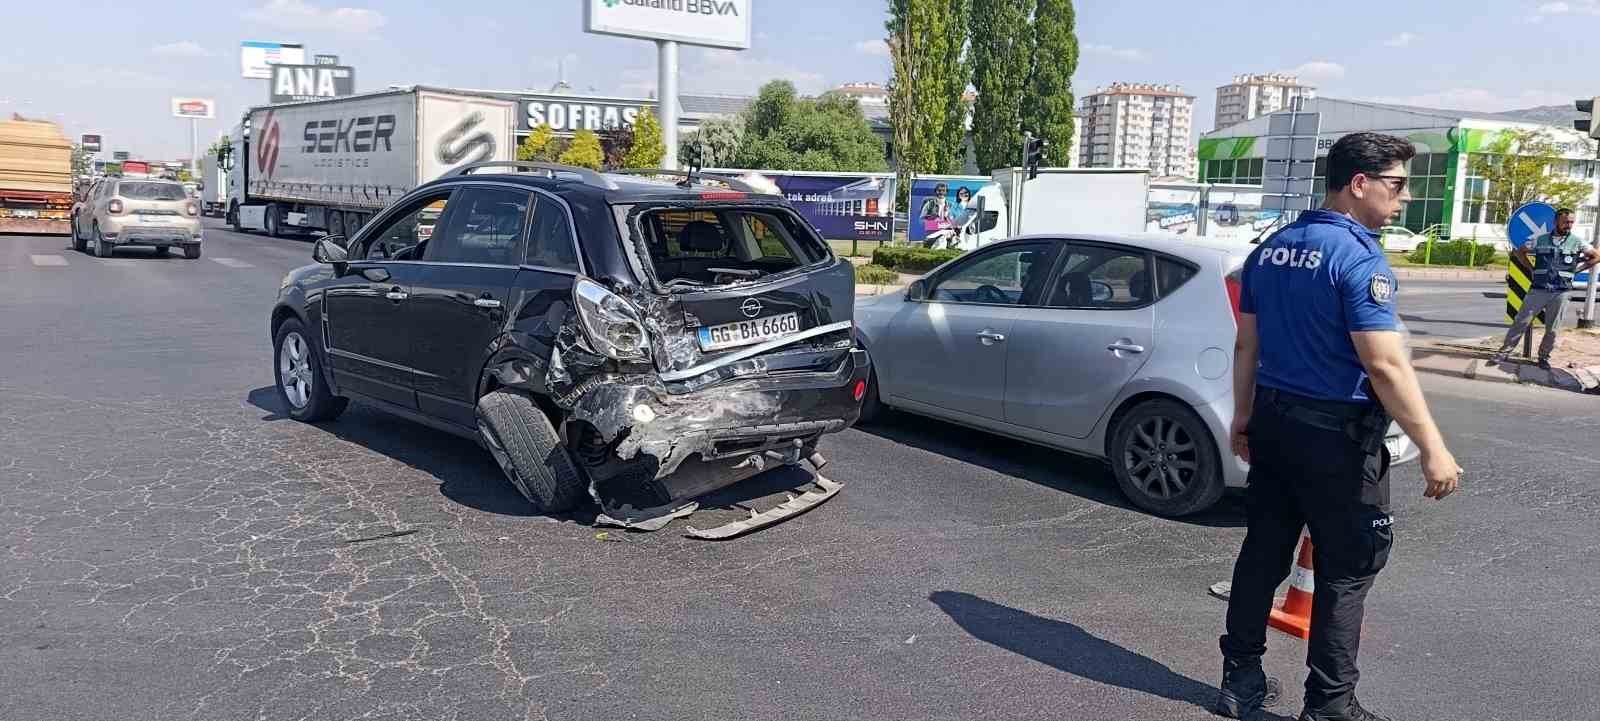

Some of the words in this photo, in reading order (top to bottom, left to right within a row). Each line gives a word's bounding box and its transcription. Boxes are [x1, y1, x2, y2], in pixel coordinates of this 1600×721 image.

[687, 0, 739, 16] BBVA
[275, 67, 336, 97] ANA
[527, 102, 640, 131] SOFRAS
[854, 221, 888, 231] SHN
[710, 327, 731, 344] GG
[740, 325, 760, 339] BA
[763, 315, 797, 335] 6660
